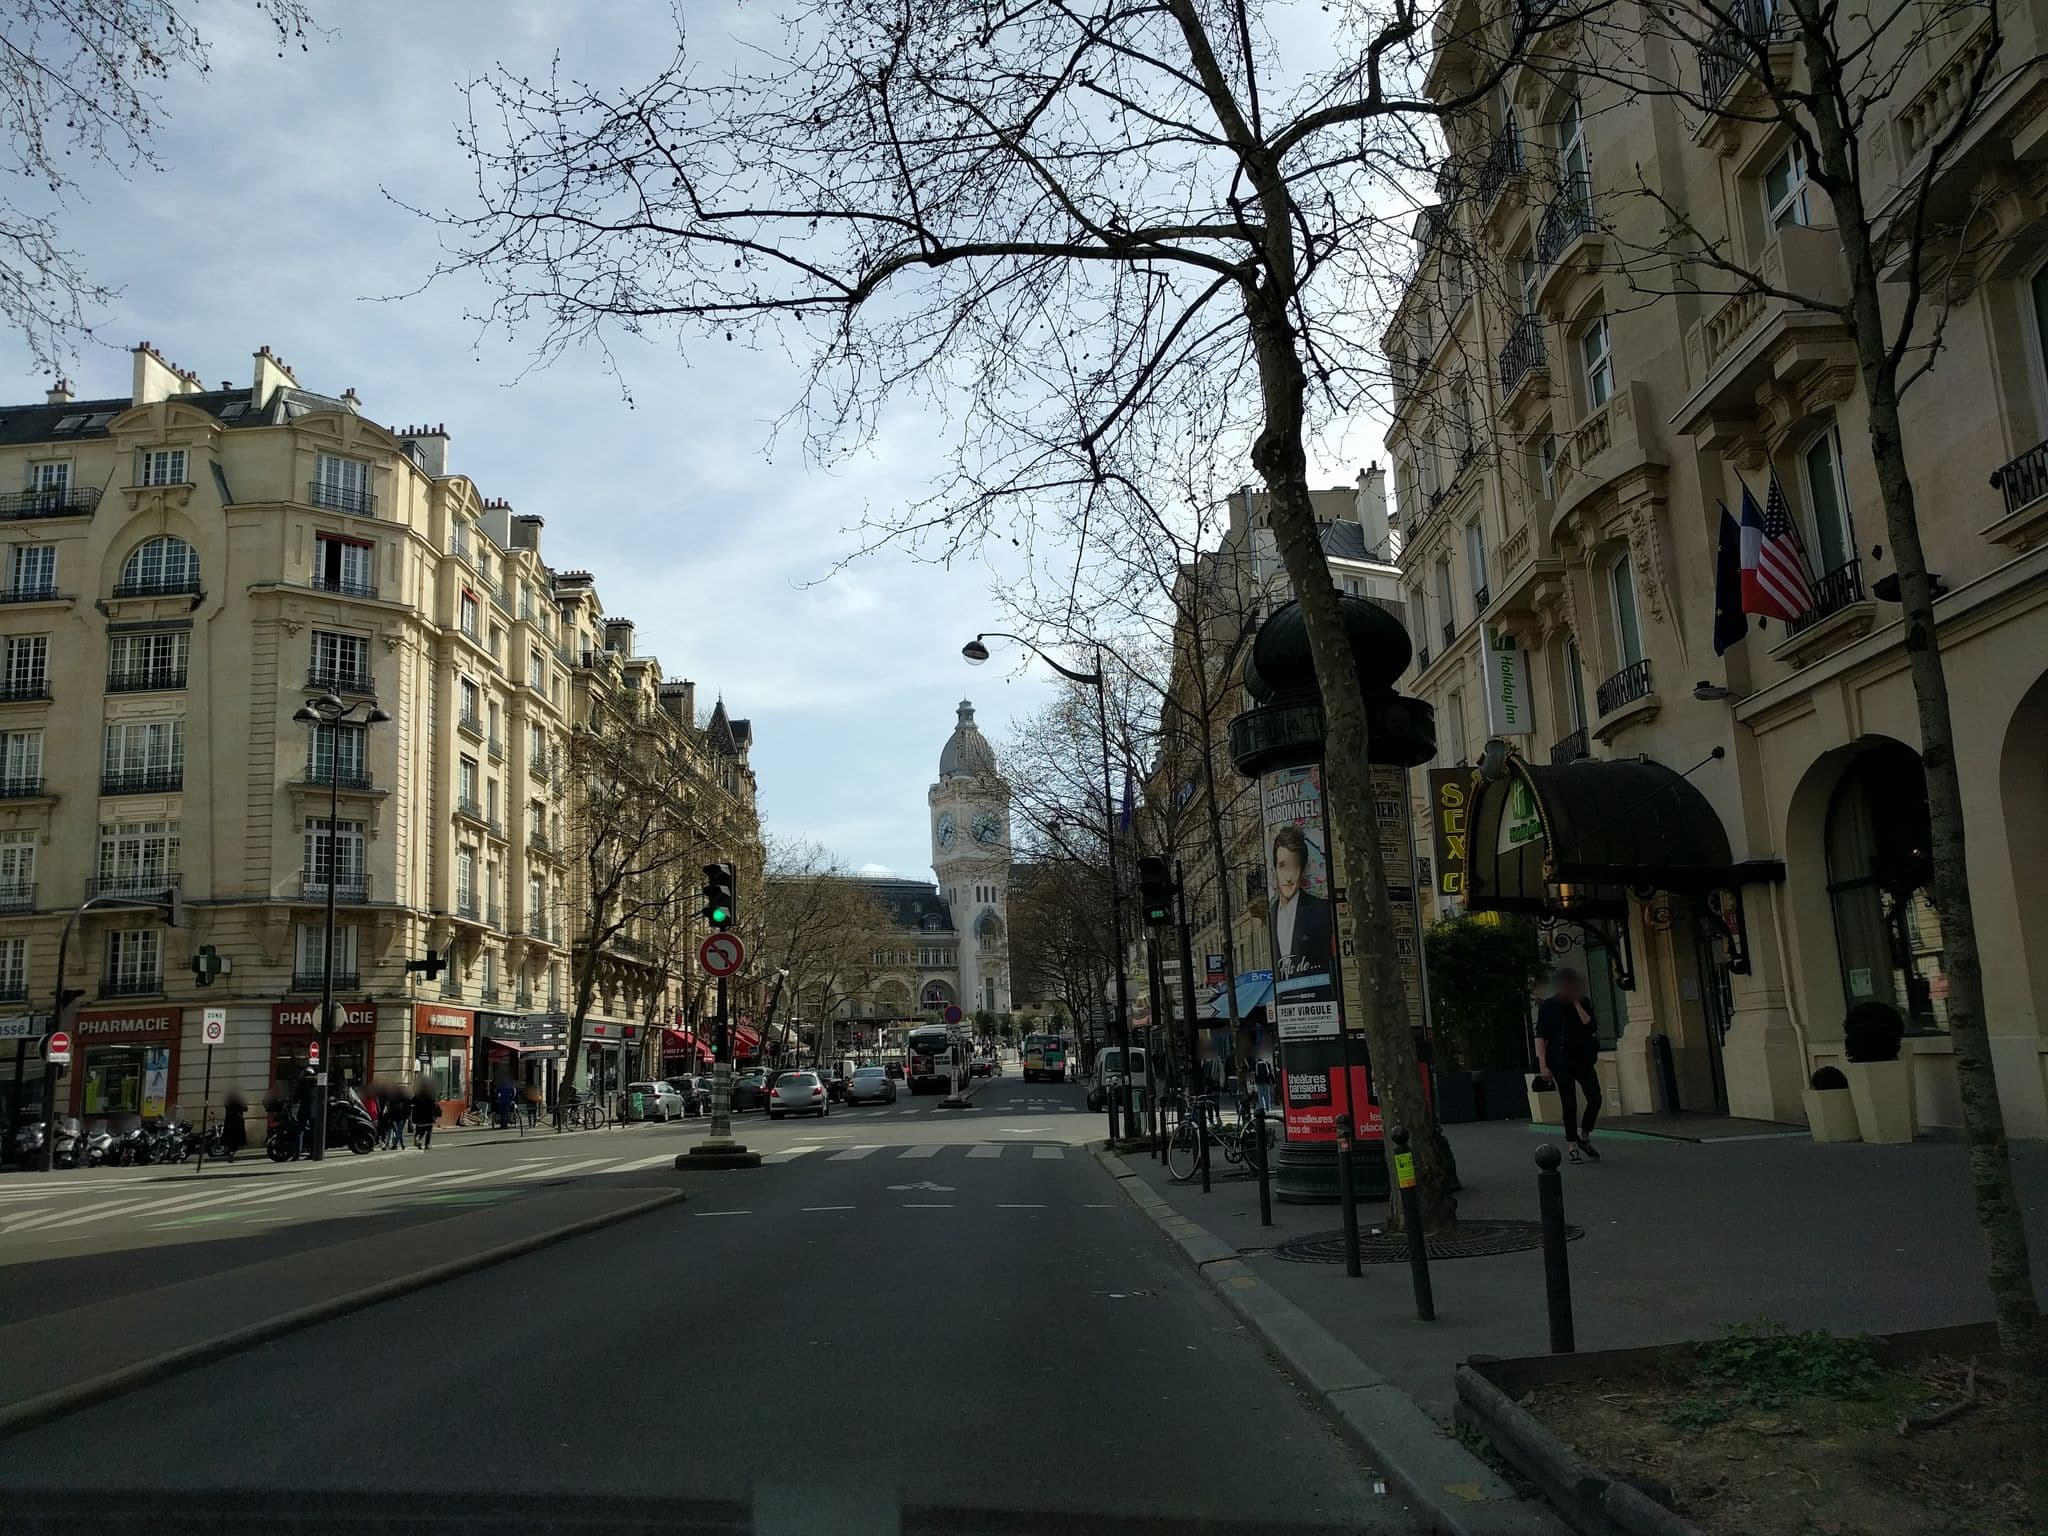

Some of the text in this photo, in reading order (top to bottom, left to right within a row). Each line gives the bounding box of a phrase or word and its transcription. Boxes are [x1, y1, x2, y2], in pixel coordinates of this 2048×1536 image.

[1500, 655, 1518, 724] Holiday Inn
[1441, 782, 1466, 860] SEX
[78, 1017, 170, 1035] PHARMACIE
[279, 1011, 374, 1025] PHAACIE
